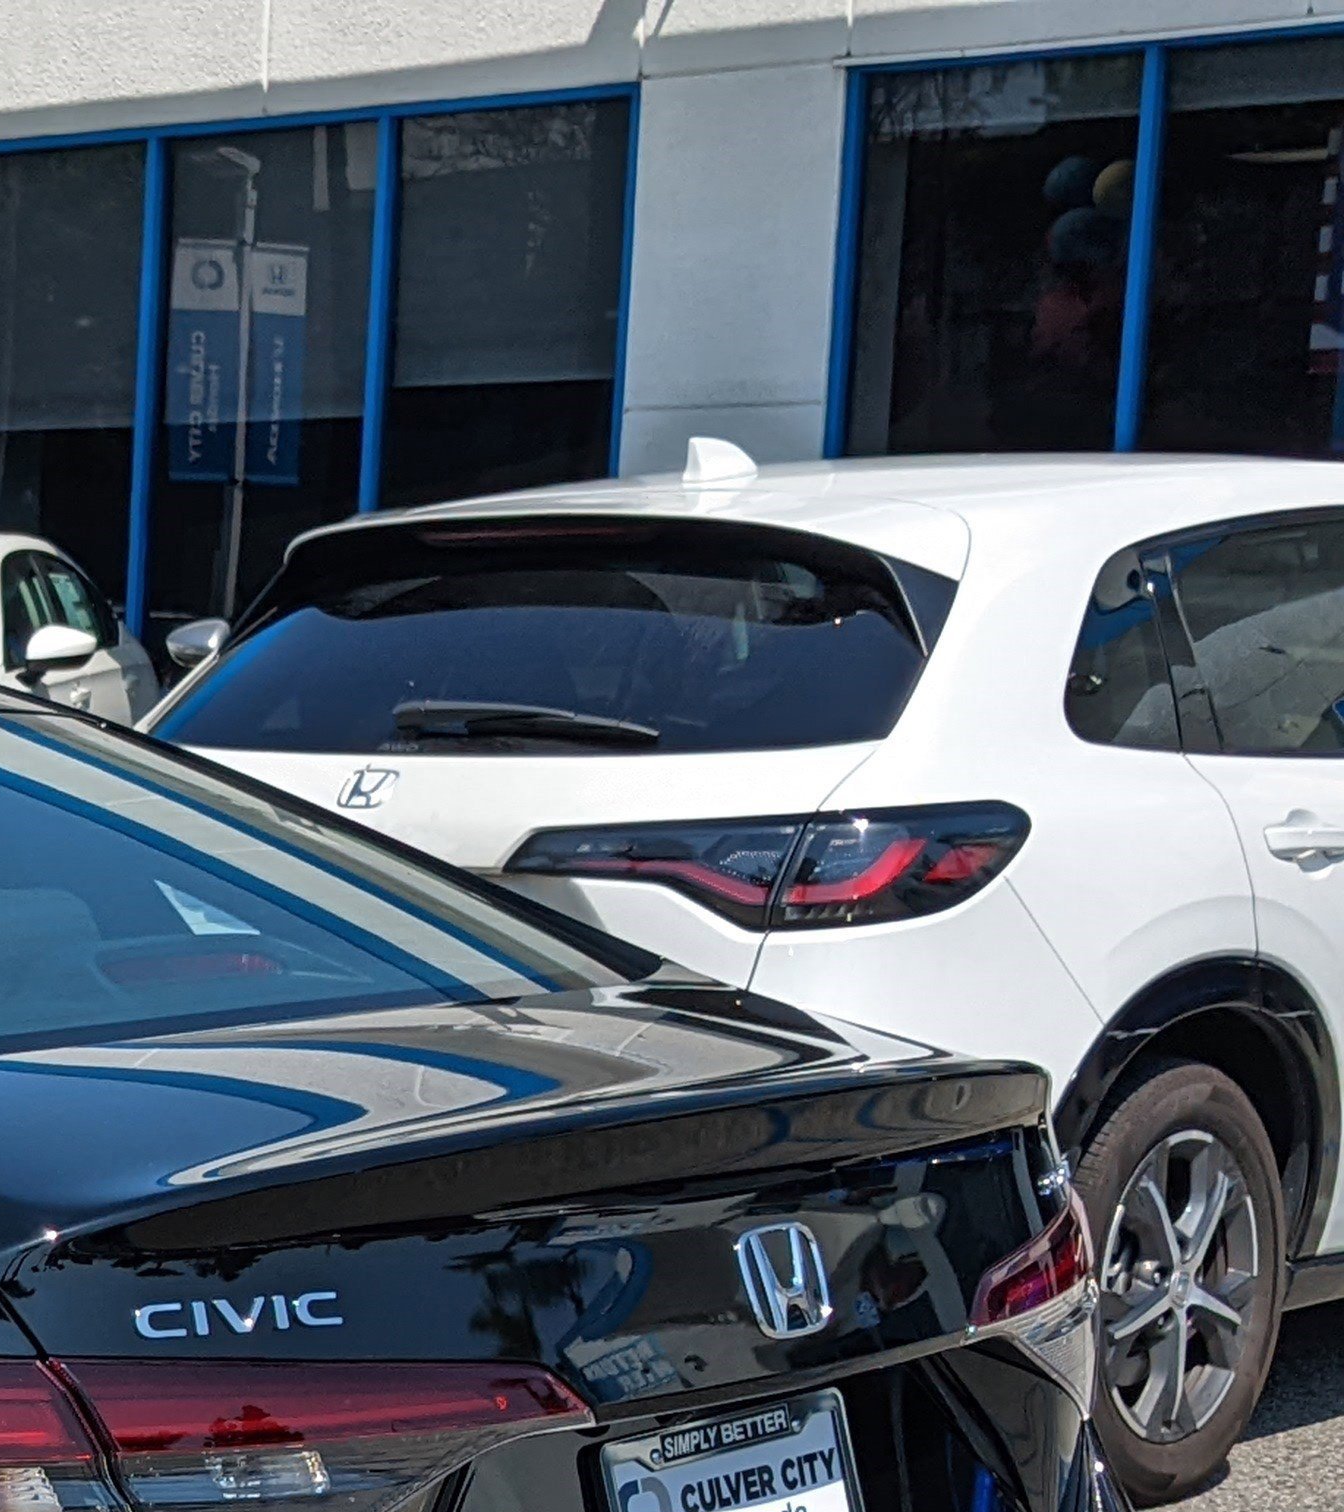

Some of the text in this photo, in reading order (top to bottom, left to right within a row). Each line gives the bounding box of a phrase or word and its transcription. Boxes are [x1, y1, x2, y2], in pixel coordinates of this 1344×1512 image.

[134, 1291, 344, 1339] CIVIC
[664, 1408, 788, 1459] SIMPLY BETTER
[780, 1447, 836, 1491] CITY
